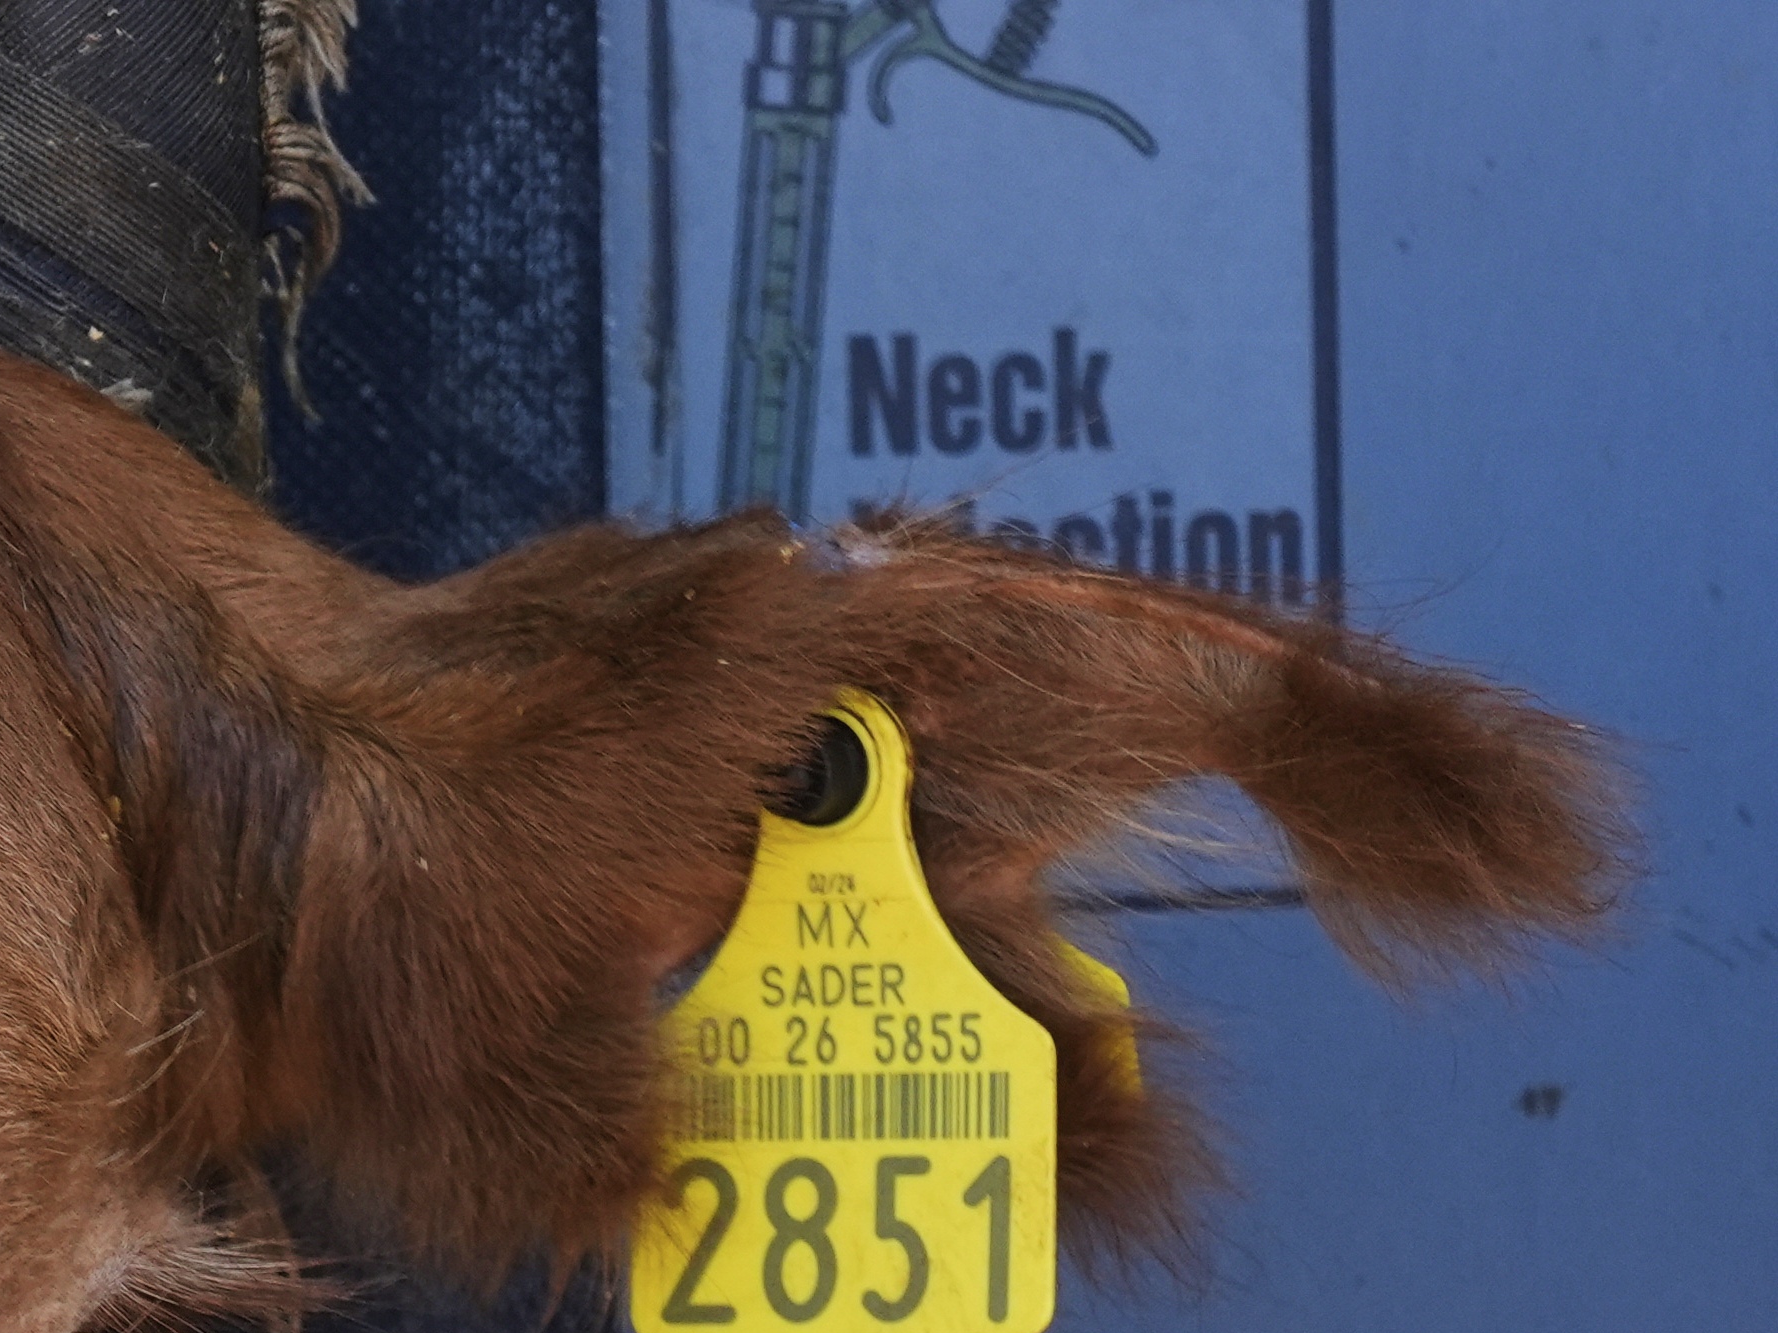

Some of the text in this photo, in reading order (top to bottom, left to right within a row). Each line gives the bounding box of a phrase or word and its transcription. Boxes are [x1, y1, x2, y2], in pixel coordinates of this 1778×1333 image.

[848, 326, 1113, 456] Neck
[797, 902, 870, 948] MX
[760, 964, 906, 1008] SADER
[699, 1013, 982, 1067] 00 26 5855
[661, 1155, 1012, 1324] 2851
